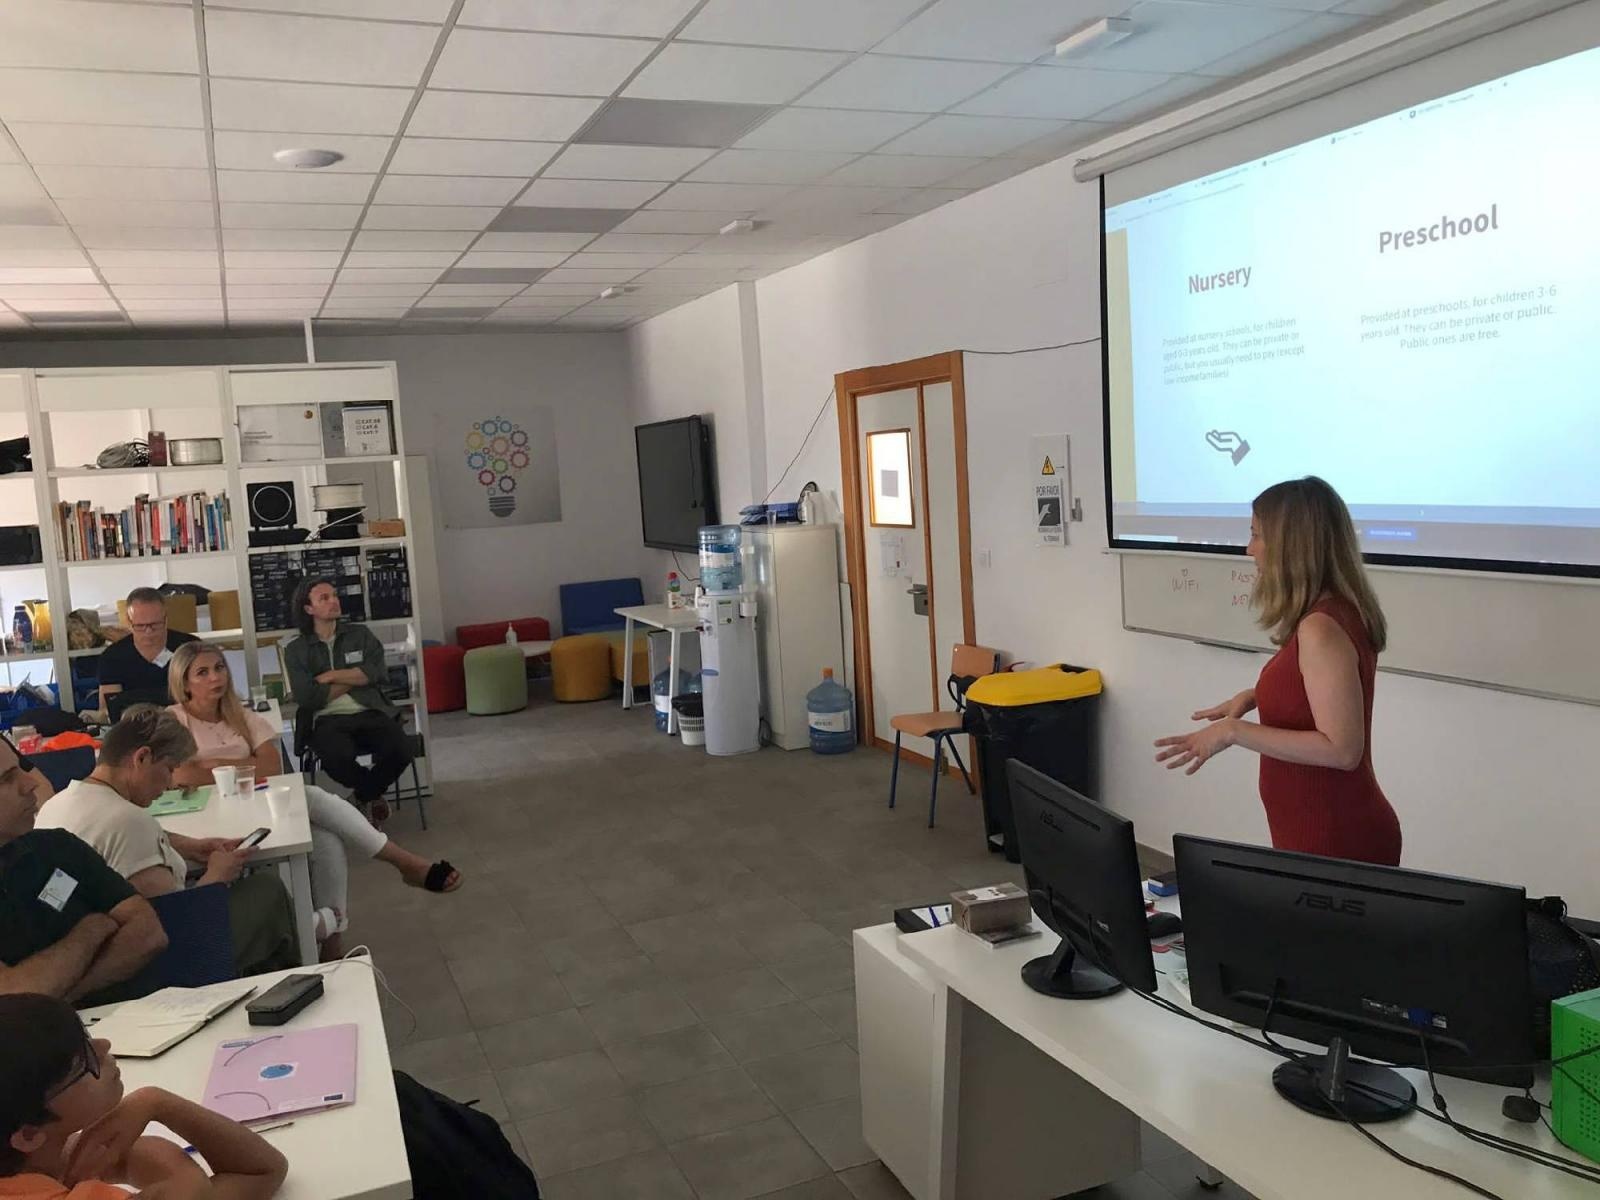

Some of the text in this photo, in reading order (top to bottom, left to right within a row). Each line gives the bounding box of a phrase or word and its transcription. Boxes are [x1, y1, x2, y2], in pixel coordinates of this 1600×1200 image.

[1378, 203, 1499, 254] Preschool
[1188, 266, 1252, 294] Nursery
[1360, 310, 1400, 325] Provided
[1401, 308, 1411, 318] at
[1473, 296, 1489, 308] for
[1490, 290, 1535, 305] children
[1162, 333, 1189, 346] Provided
[1197, 331, 1224, 341] nursery
[1253, 322, 1264, 332] for
[1265, 317, 1297, 330] children
[1360, 329, 1383, 343] years
[1404, 322, 1427, 336] They
[1428, 319, 1447, 332] can
[1449, 317, 1464, 329] be
[1464, 311, 1501, 328] private
[1503, 309, 1514, 321] or
[1399, 335, 1430, 350] Public
[1431, 333, 1457, 346] ones
[1459, 330, 1475, 343] are
[1222, 340, 1239, 352] They
[1240, 338, 1252, 348] can
[1263, 331, 1289, 345] private
[1210, 354, 1234, 367] usually
[1235, 352, 1253, 363] need
[1253, 350, 1262, 360] to
[1295, 891, 1366, 917] ASUS
